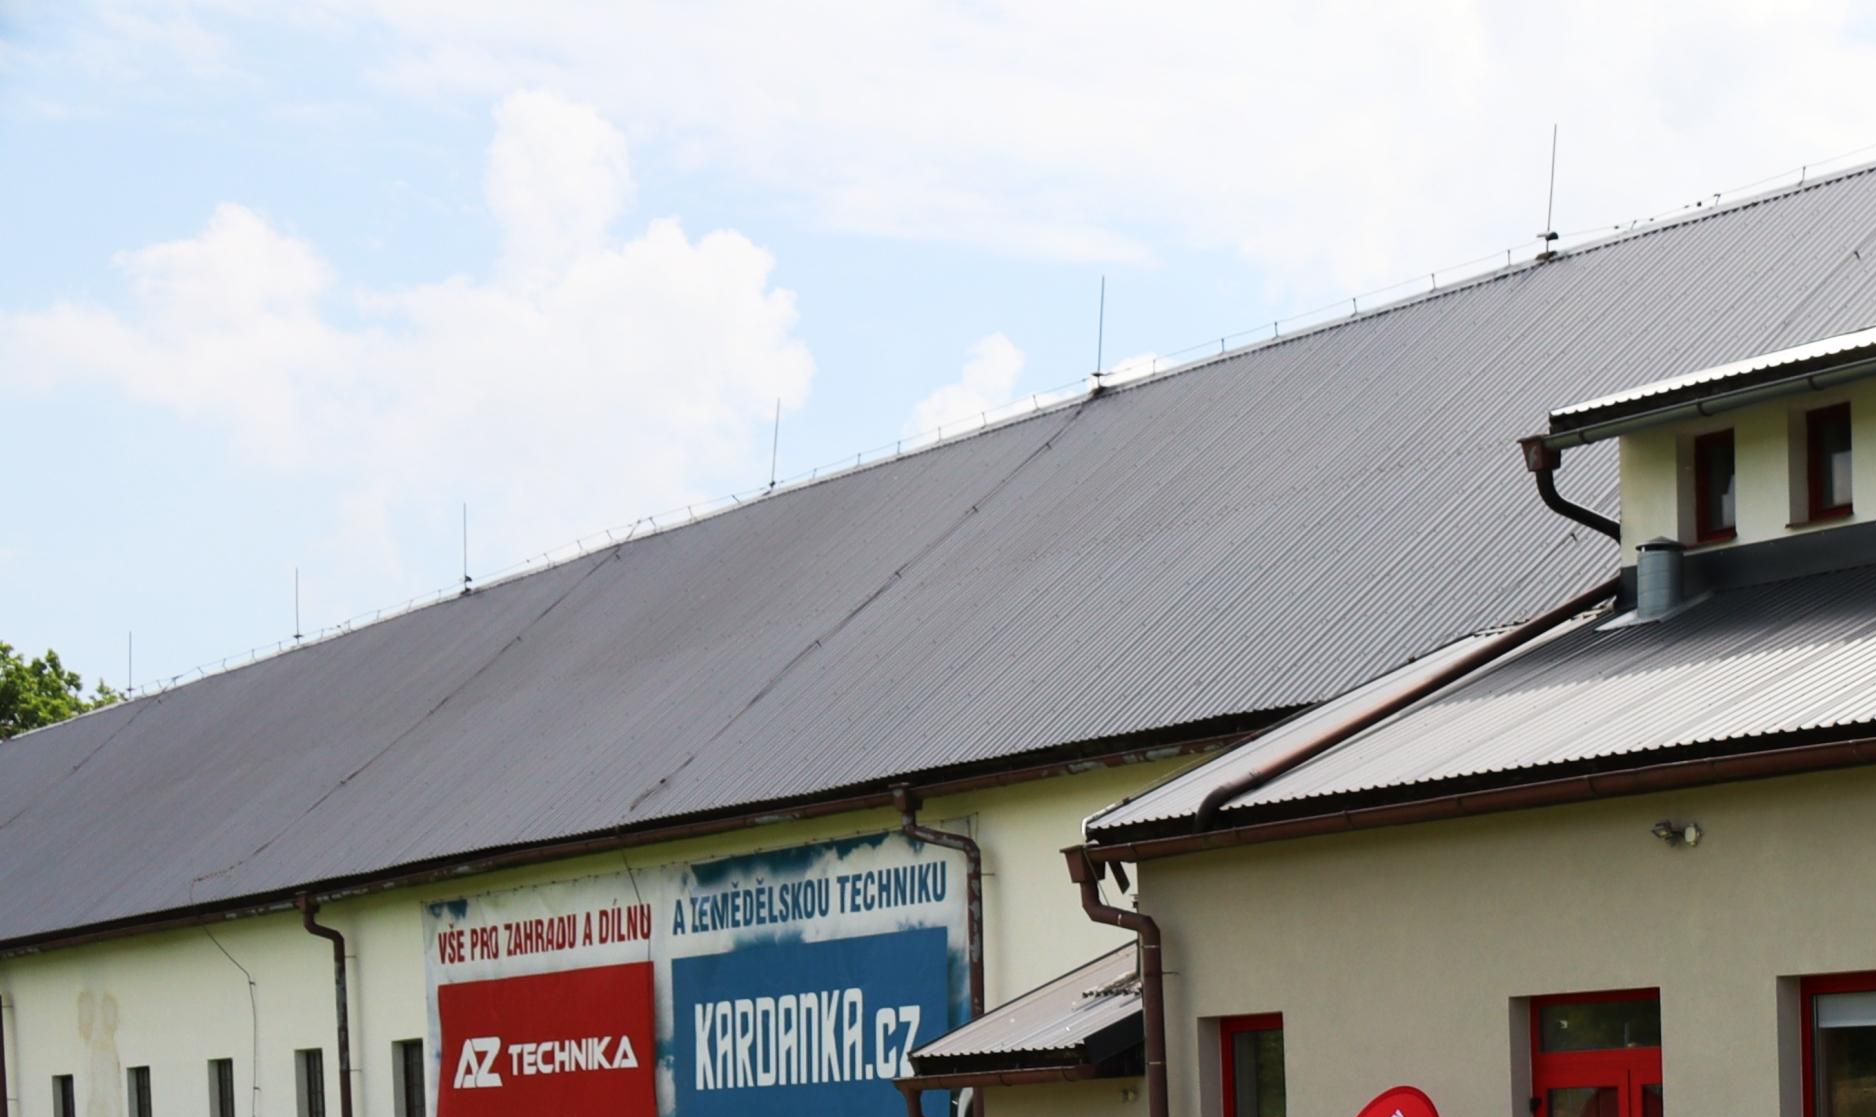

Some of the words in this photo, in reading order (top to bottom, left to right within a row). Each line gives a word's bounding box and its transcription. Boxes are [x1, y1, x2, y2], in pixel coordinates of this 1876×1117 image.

[438, 923, 465, 965] VŠE
[470, 925, 499, 962] PRO
[504, 912, 577, 957] ZAHRADU
[582, 912, 593, 947] A
[599, 898, 651, 945] DÍLNU
[672, 899, 686, 936] A
[690, 877, 829, 934] ZEMĚDĚLSKOU
[837, 860, 947, 914] TECHNIKU
[453, 1036, 503, 1089] AZ
[507, 1035, 639, 1076] TECHNIKA
[694, 987, 921, 1091] KARDANKA.CZ
